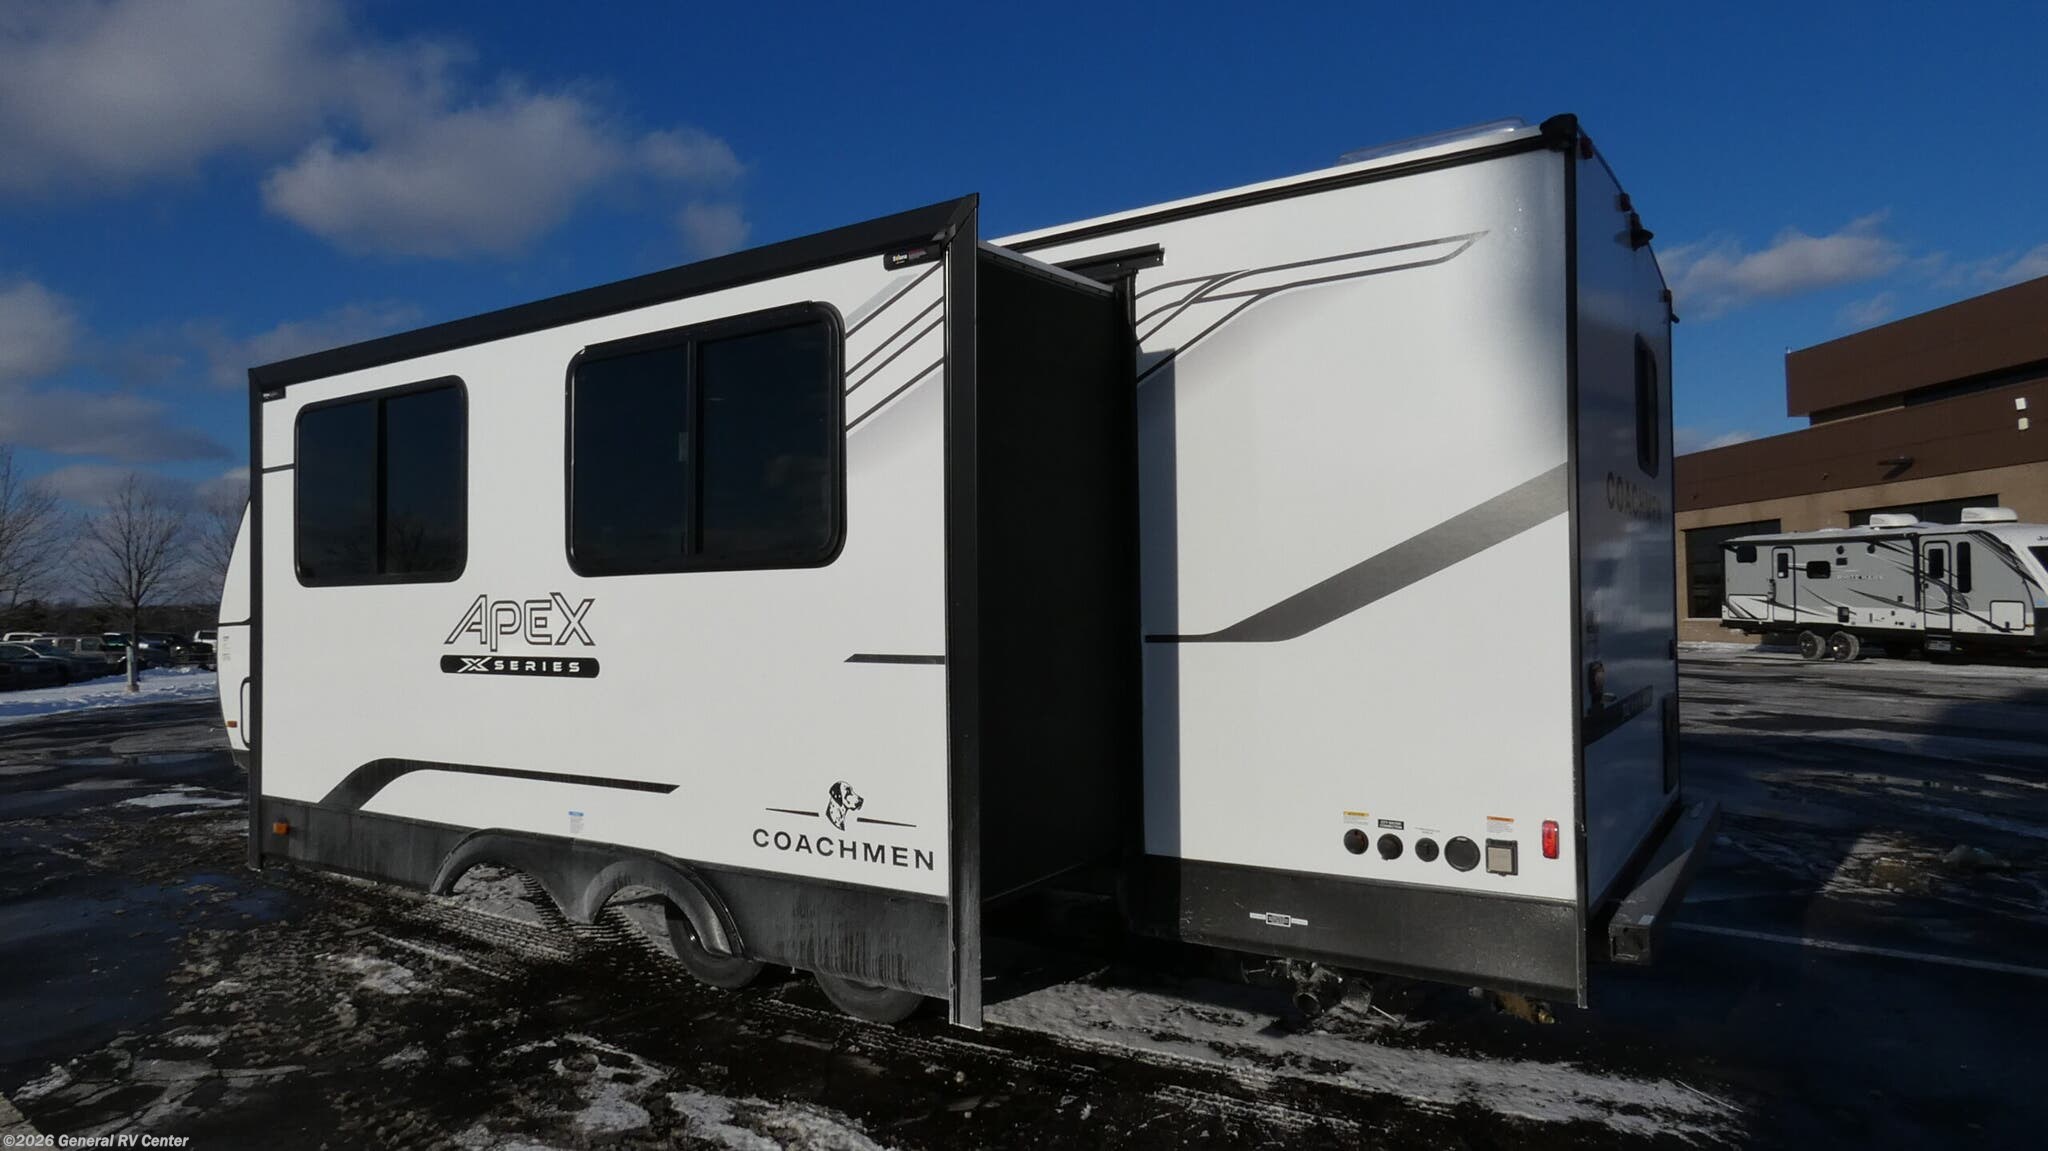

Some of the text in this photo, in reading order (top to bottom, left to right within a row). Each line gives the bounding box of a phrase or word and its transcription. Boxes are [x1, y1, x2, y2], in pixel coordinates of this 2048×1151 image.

[443, 591, 596, 652] APEX
[457, 656, 581, 673] X SERIES
[752, 828, 935, 871] COACHMEN
